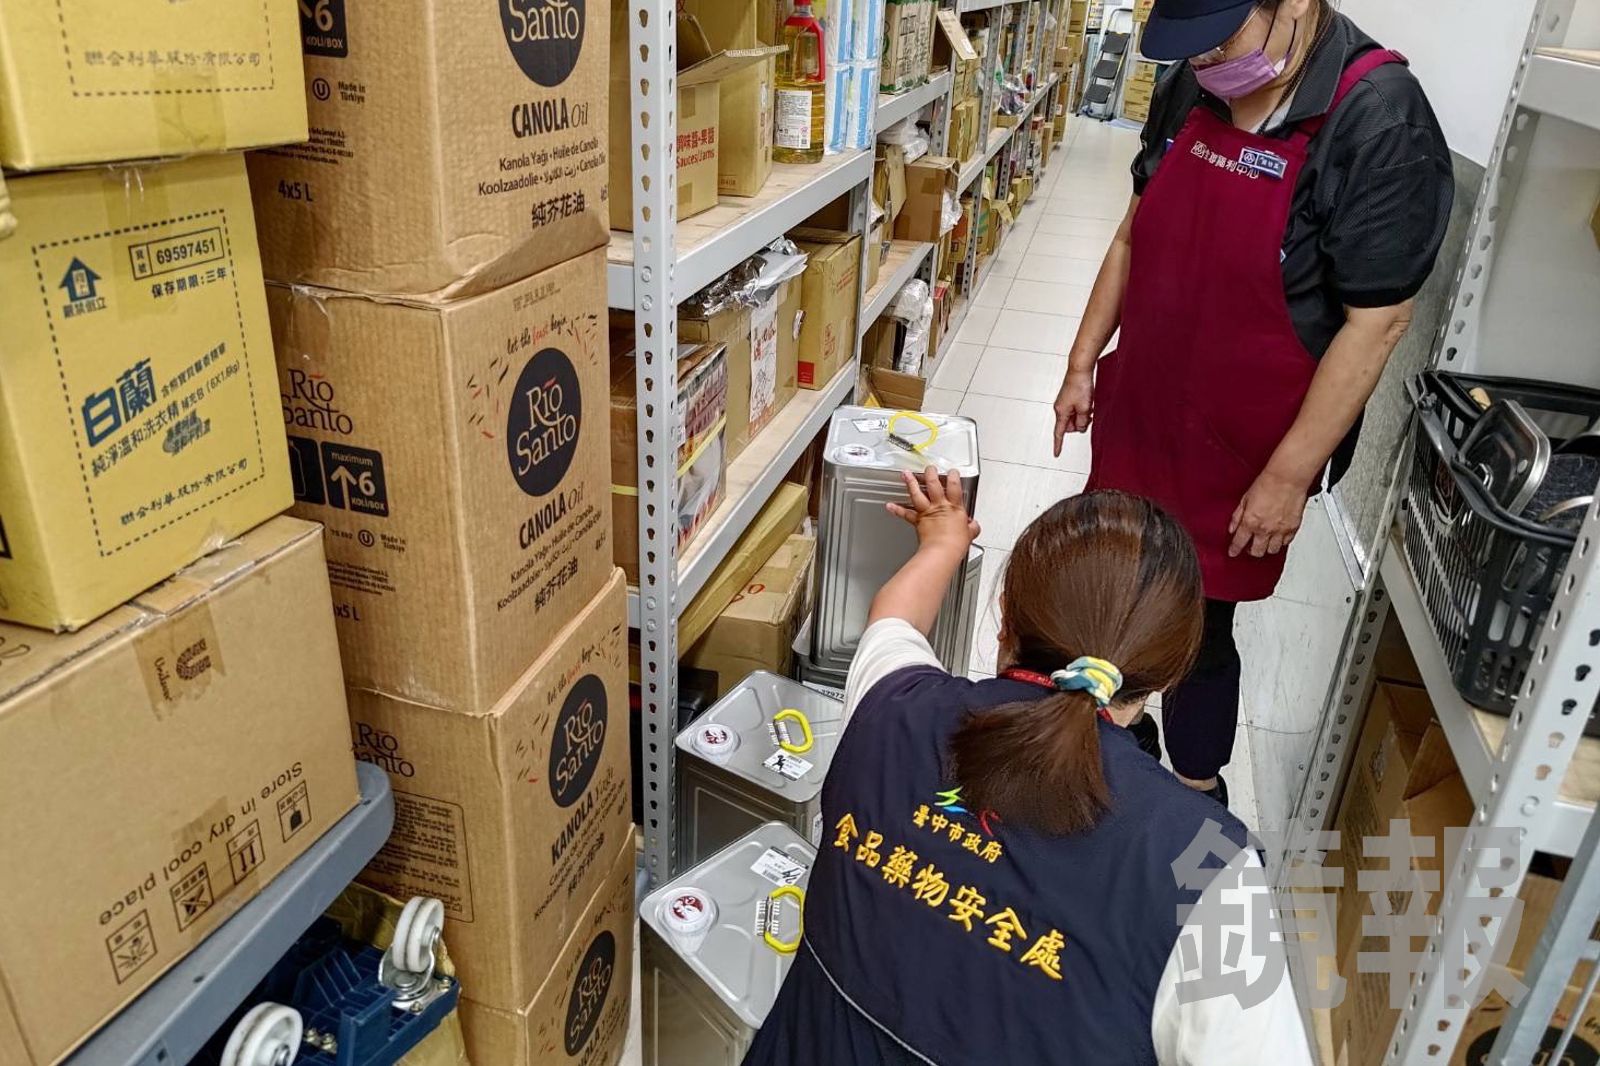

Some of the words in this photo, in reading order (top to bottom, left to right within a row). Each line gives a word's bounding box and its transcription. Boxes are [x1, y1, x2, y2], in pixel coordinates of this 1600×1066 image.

[509, 0, 580, 43] Santo
[512, 97, 569, 138] CANOLA
[571, 102, 589, 128] Oil
[499, 153, 530, 172] Kanola
[278, 180, 301, 200] 4x5
[305, 182, 314, 202] L
[478, 172, 539, 197] Koolzaadolie
[532, 187, 585, 229] 純芥花油
[156, 237, 217, 265] 69597451
[82, 357, 157, 448] 白蘭
[331, 451, 374, 467] maximum
[516, 411, 577, 476] Santo
[359, 471, 376, 497] 6
[519, 492, 567, 550] CANOLA
[568, 482, 585, 510] Oil
[555, 719, 604, 797] Santo
[259, 761, 304, 801] Store
[240, 796, 257, 817] in
[207, 815, 236, 846] dry
[551, 791, 594, 866] KANOLA
[912, 804, 1004, 864] 臺中市政府
[162, 843, 204, 881] cool
[97, 875, 156, 927] place
[833, 812, 1066, 980] 食品藥物安全處
